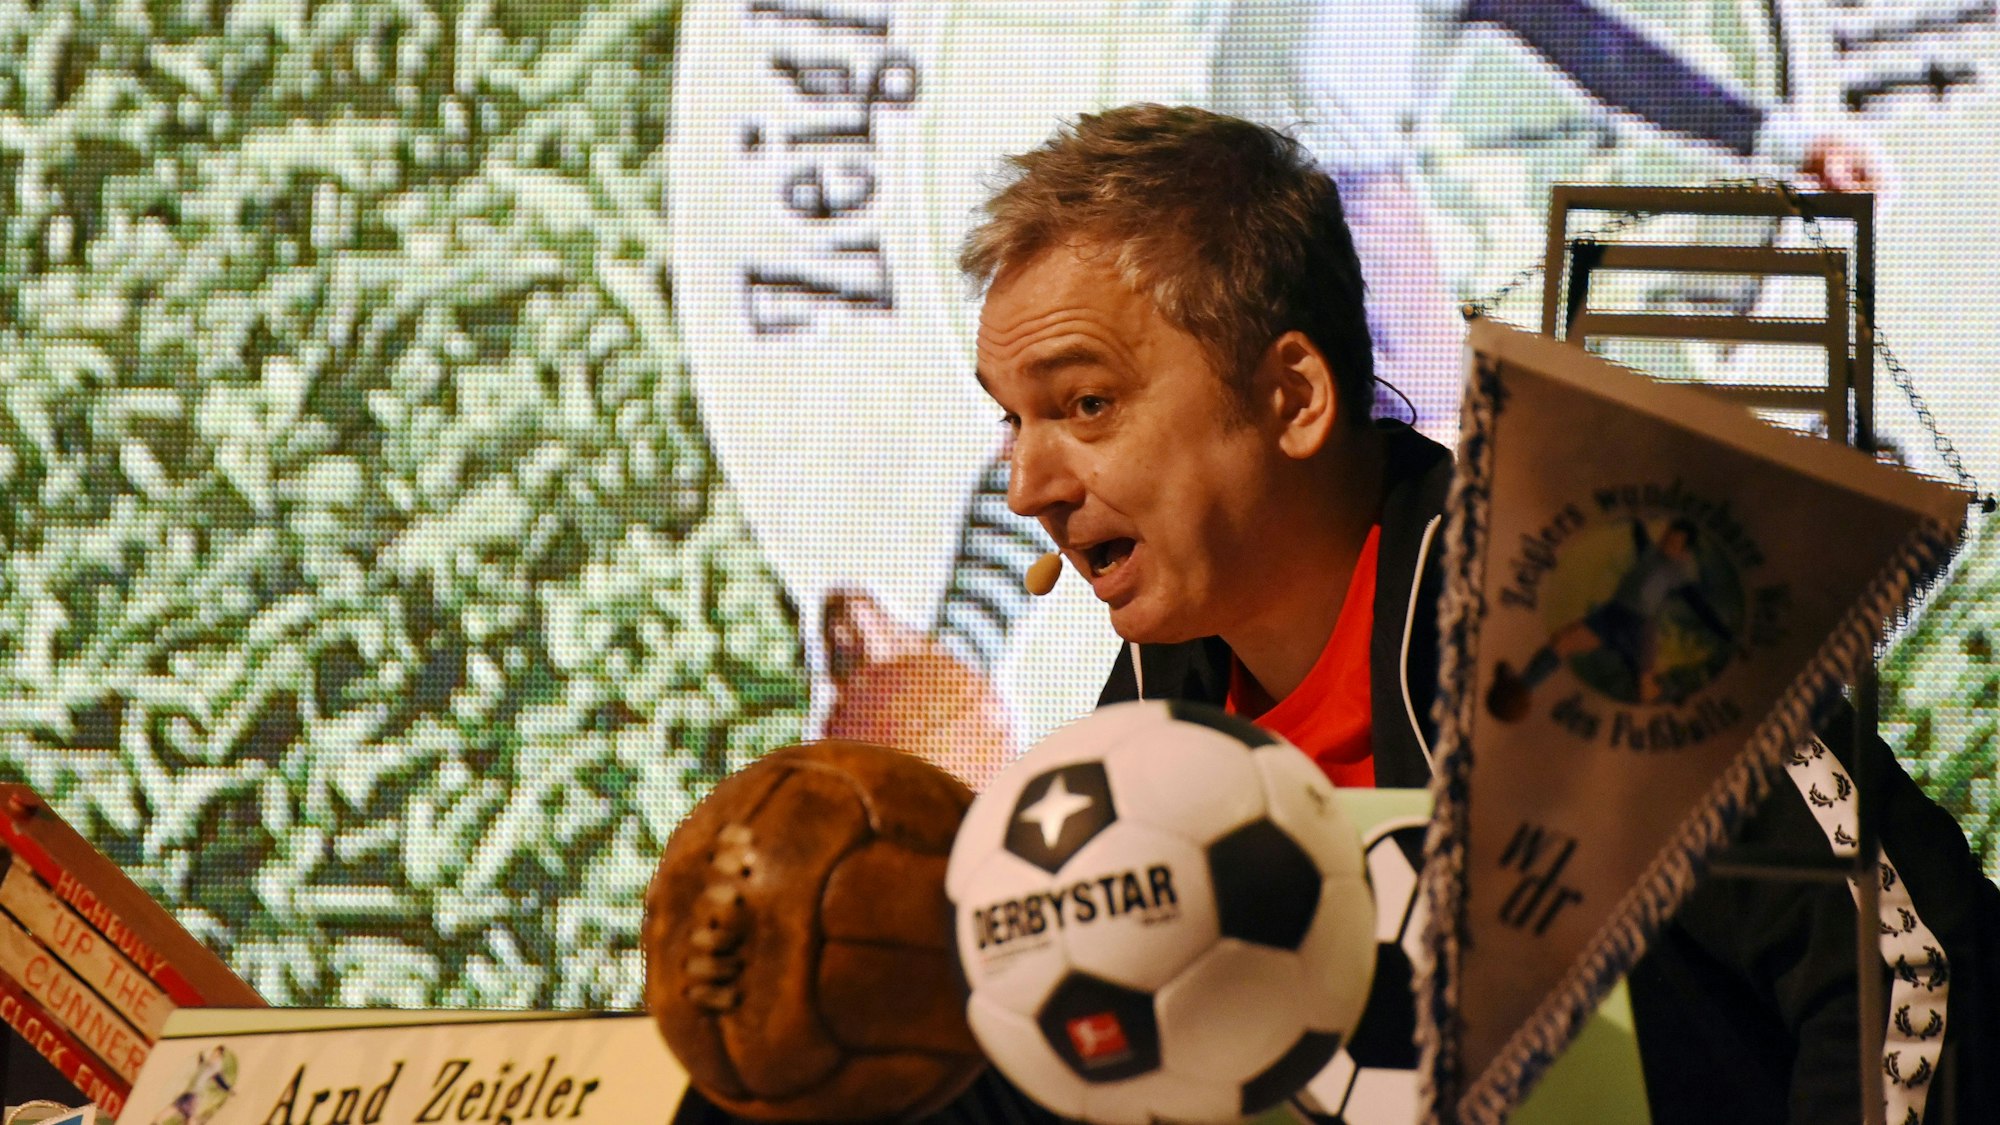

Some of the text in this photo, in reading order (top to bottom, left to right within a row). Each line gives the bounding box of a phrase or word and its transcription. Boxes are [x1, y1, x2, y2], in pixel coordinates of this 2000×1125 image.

[974, 865, 1178, 950] DERBYSTAR
[103, 957, 156, 1023] THE
[1, 995, 121, 1122] CLOCK END
[262, 1056, 600, 1125] Arnd Zeigler
